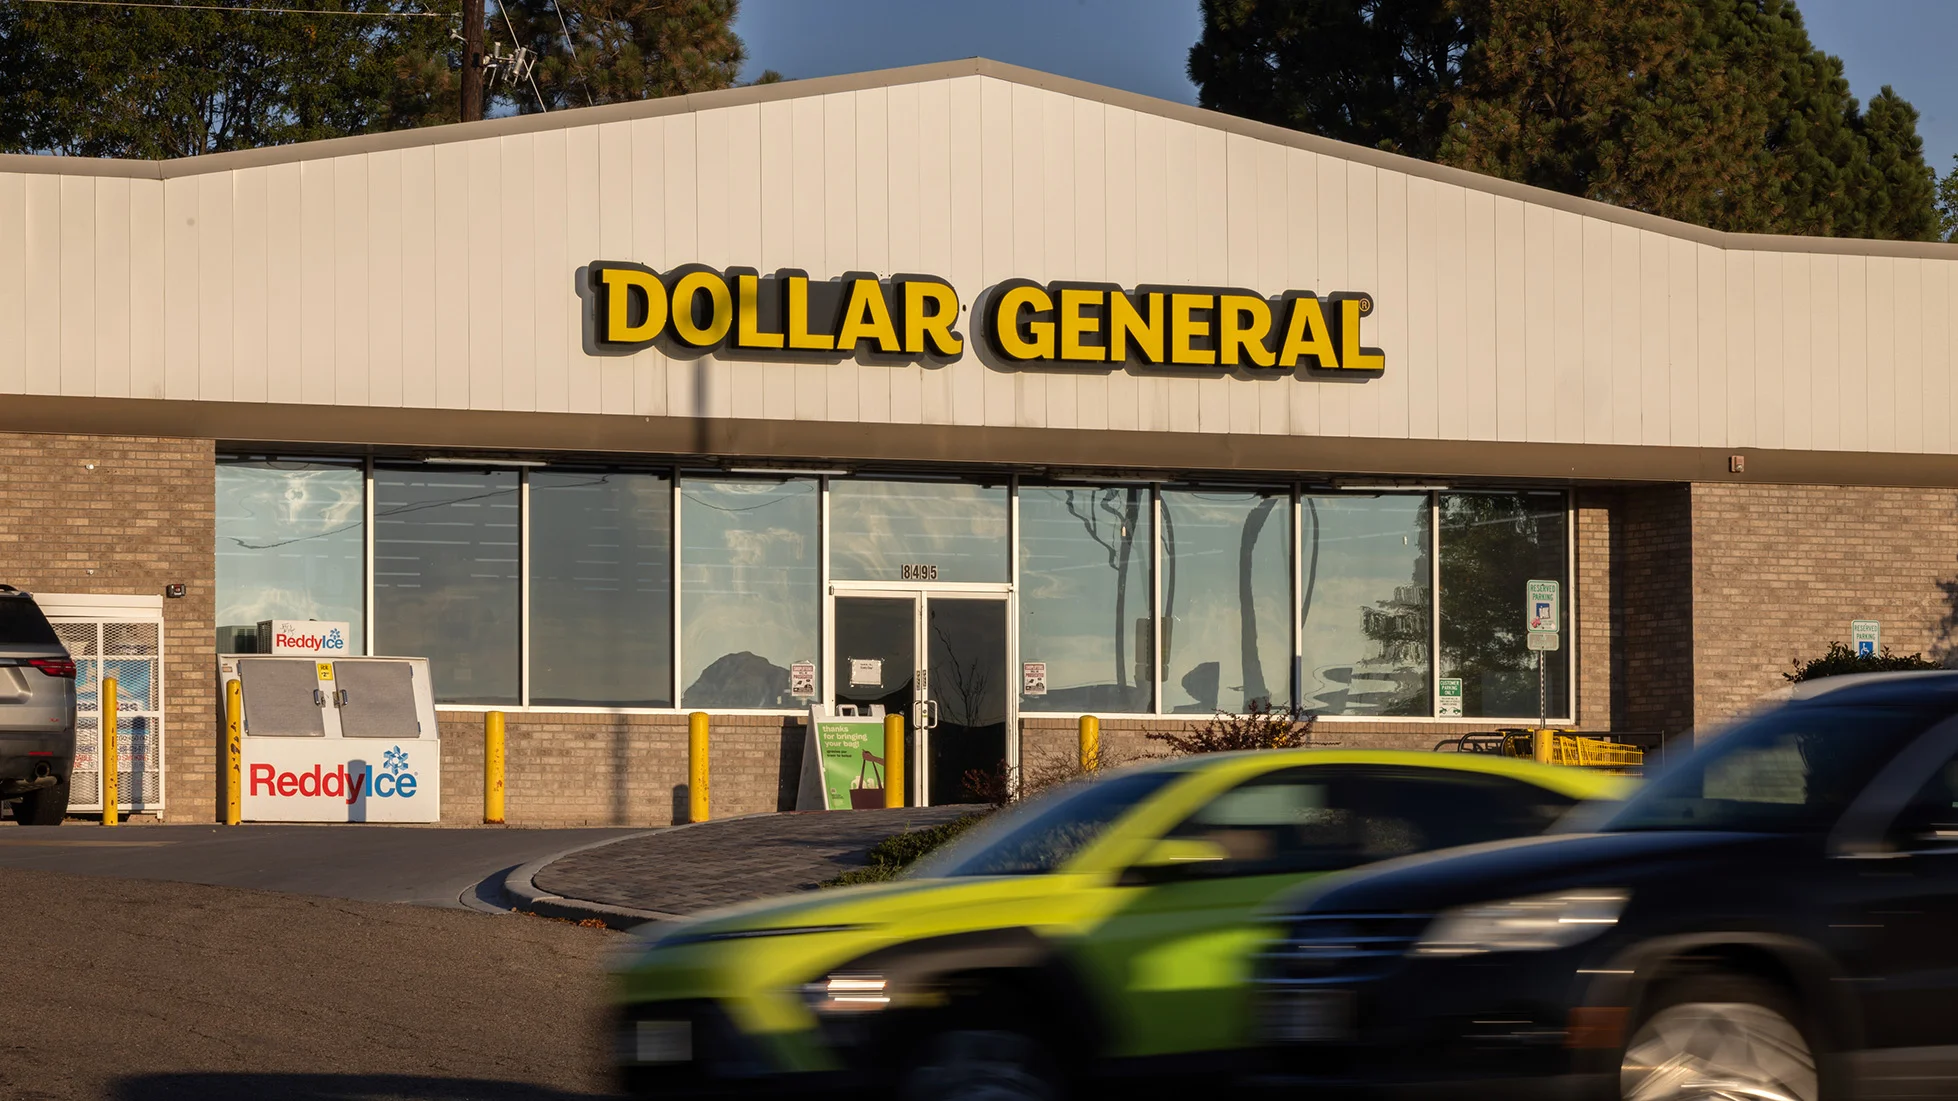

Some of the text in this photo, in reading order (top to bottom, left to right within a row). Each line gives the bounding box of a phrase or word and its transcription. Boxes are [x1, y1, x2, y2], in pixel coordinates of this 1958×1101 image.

[600, 267, 964, 356] DOLLAR
[903, 564, 938, 580] 8495
[1530, 584, 1556, 593] RESERVED
[1532, 593, 1554, 601] PARKING
[1854, 624, 1878, 632] RESERVED
[276, 633, 344, 651] ReddyIce
[822, 725, 849, 733] thanks
[836, 733, 868, 742] bringing
[249, 763, 418, 805] ReddyIce
